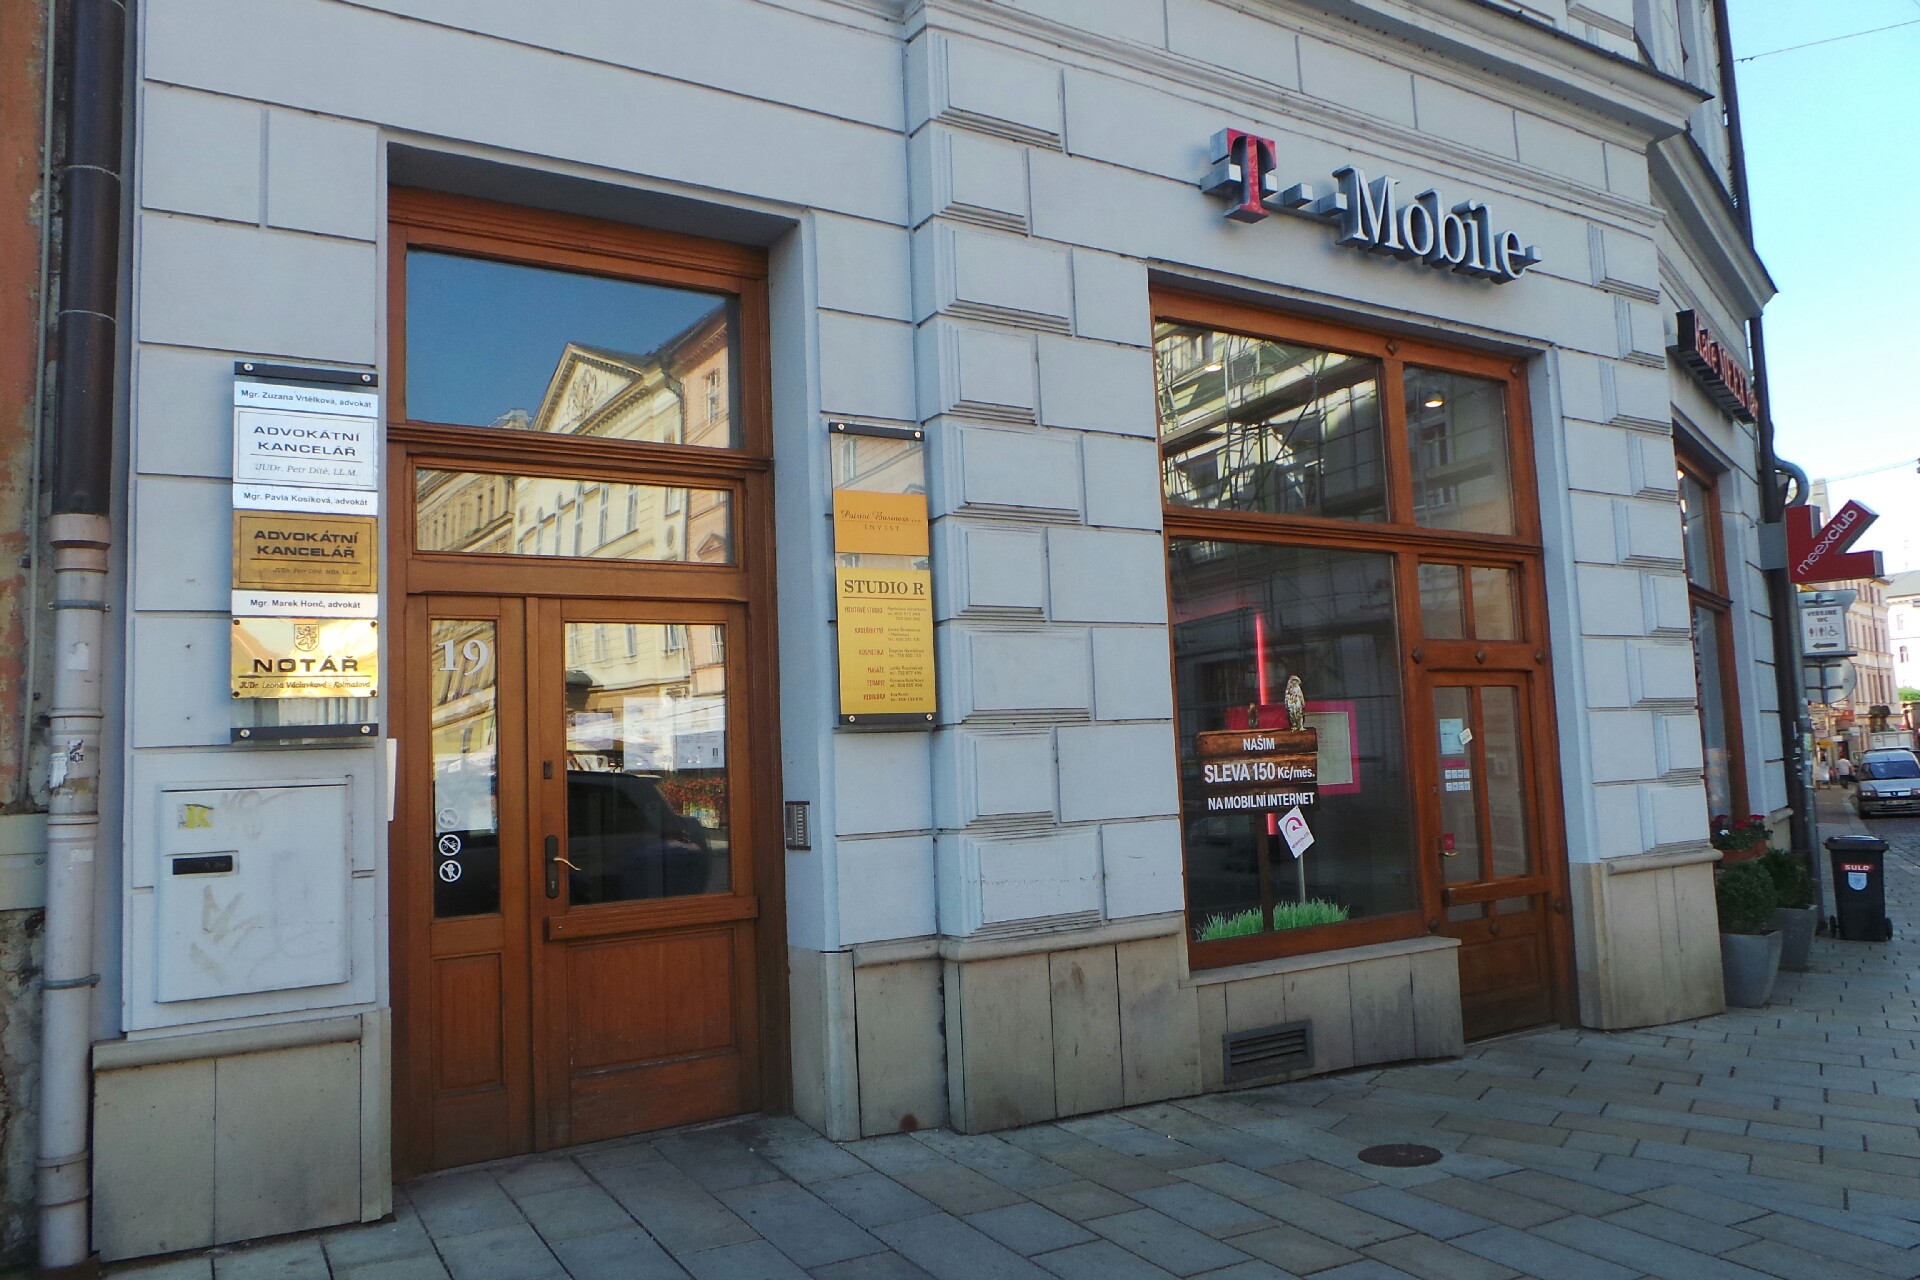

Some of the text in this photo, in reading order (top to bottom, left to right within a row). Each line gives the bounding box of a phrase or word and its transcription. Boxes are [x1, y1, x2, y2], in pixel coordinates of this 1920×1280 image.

[241, 389, 260, 399] Mgr.
[262, 391, 294, 401] Zuzana
[339, 398, 372, 409] advokát
[253, 426, 360, 442] ADVOKÁTNÍ
[258, 441, 356, 457] KANCELÁŘ
[287, 465, 306, 474] Petr
[243, 492, 262, 502] Mgr.
[264, 493, 289, 502] Pavla
[334, 498, 368, 506] advokát
[864, 524, 901, 532] INVEST
[254, 529, 360, 544] ADVOKÁTNÍ
[1796, 508, 1858, 575] meexclub
[257, 545, 355, 558] KANCELÁŘ
[844, 579, 925, 596] STUDIO R
[250, 599, 269, 608] Mgr.
[271, 599, 298, 607] Marek
[327, 601, 361, 609] advokát
[253, 655, 359, 673] NOTÁŘ
[436, 639, 489, 676] 19
[262, 681, 284, 689] Leona
[1243, 736, 1275, 751] NAŠIM
[1204, 762, 1315, 784] SLEVA 150 Kč/měs.
[1207, 791, 1315, 811] NA MOBILNÍ INTERNET
